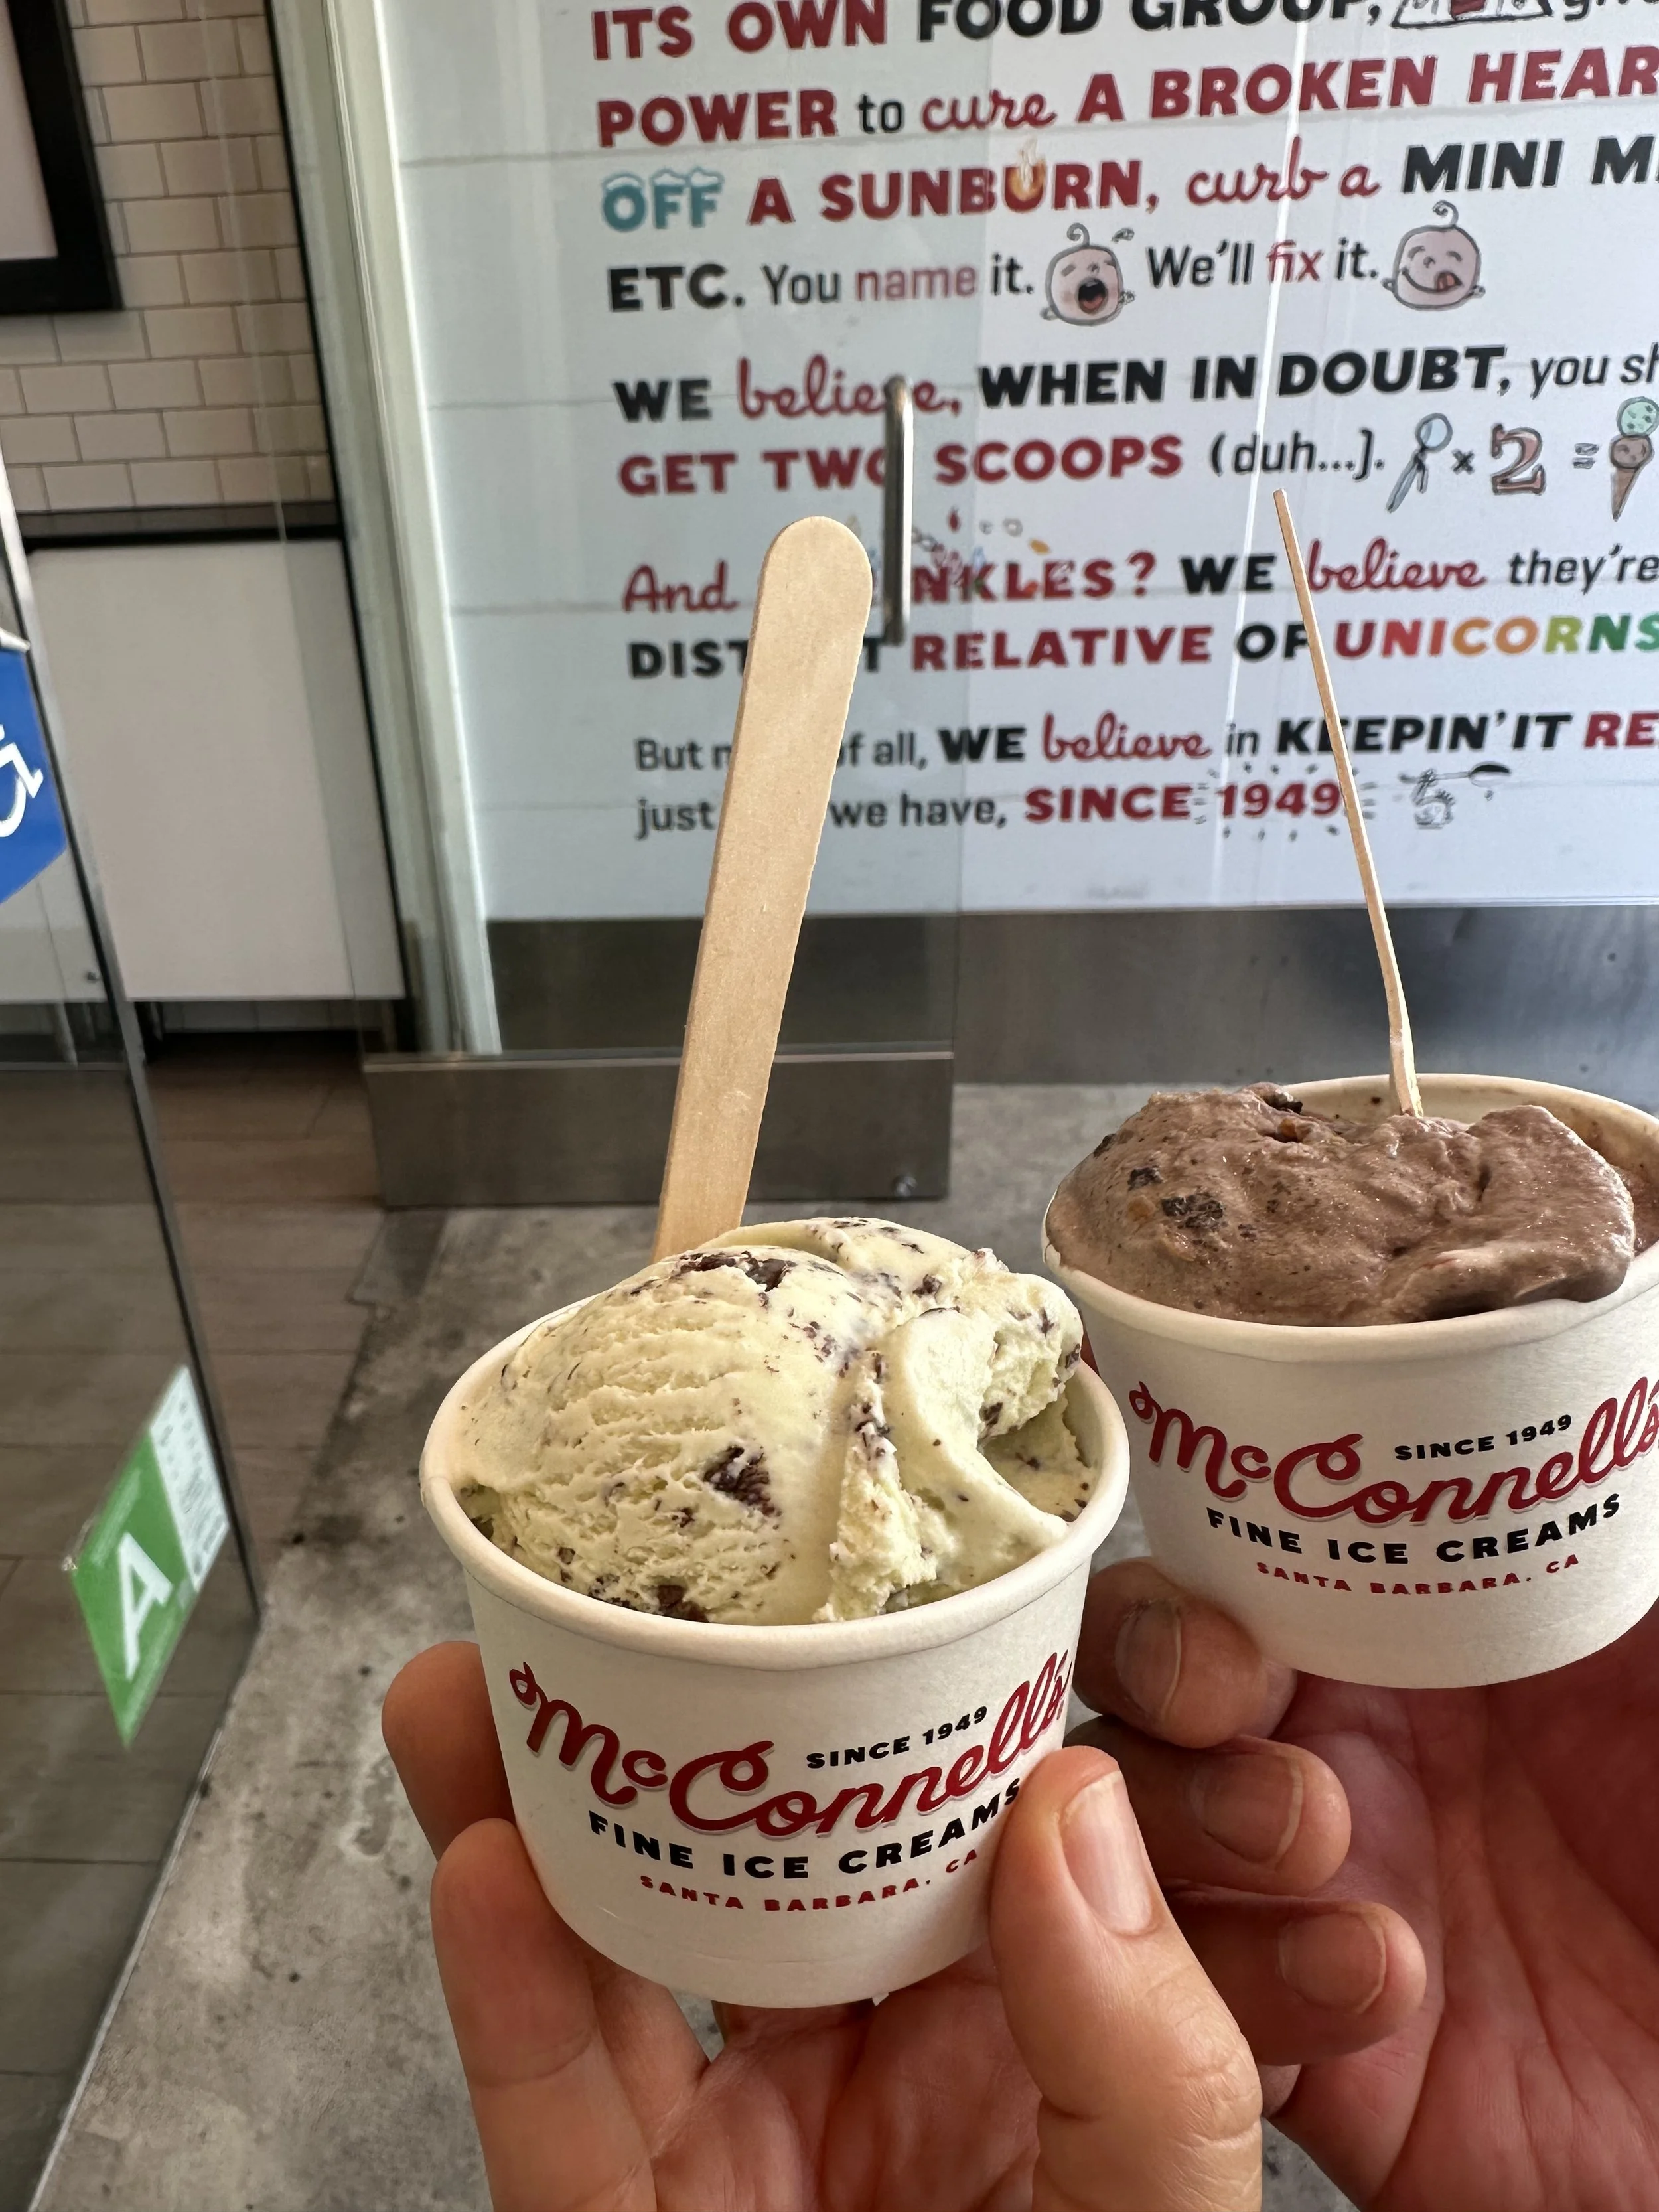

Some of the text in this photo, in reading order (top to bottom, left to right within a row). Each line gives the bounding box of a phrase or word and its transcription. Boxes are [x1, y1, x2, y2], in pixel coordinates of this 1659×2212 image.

[592, 5, 693, 60] ITS
[727, 0, 887, 54] OWN
[918, 0, 1102, 42] FOOD
[597, 90, 838, 148] POWER
[858, 93, 904, 133] to
[920, 90, 1056, 132] cure
[1077, 72, 1124, 123] A
[1151, 55, 1438, 120] BROKEN
[601, 134, 1659, 232] OFF A SUNBURN, curb a MINI M
[609, 264, 746, 312] ETC.
[762, 264, 841, 305] You
[855, 262, 977, 304] name
[991, 254, 1035, 297] it.
[1267, 240, 1323, 282] fix
[1335, 237, 1378, 281] it.
[613, 378, 712, 421] WE
[735, 354, 962, 419] beliee,
[977, 358, 1165, 408] WHEN
[1192, 355, 1258, 400] IN
[1277, 344, 1510, 397] DOUBT,
[1530, 354, 1609, 400] you
[618, 453, 736, 496] GET
[934, 434, 1183, 485] SCOOPS
[621, 559, 740, 613] And
[1179, 553, 1277, 595] WE
[1306, 536, 1487, 592] believe
[628, 611, 1659, 678] DISTT RELATIVE OF UNICORNS
[635, 737, 702, 771] But
[873, 731, 928, 770] all,
[936, 725, 1026, 765] WE
[1042, 710, 1212, 763] believe
[1226, 721, 1259, 757] in
[635, 781, 1342, 841] just we have, SINCE 1949
[1395, 1414, 1573, 1461] SINCE 1949
[1206, 1493, 1621, 1565] FINE ICE CREAMS
[117, 1530, 173, 1681] A
[1256, 1562, 1352, 1592] SANTA
[1546, 1554, 1579, 1574] CA
[806, 1706, 988, 1769] SINCE 1949
[589, 1777, 1021, 1879] FINE ICE CREAMS
[640, 1875, 745, 1910] SANTA
[945, 1848, 977, 1874] CA
